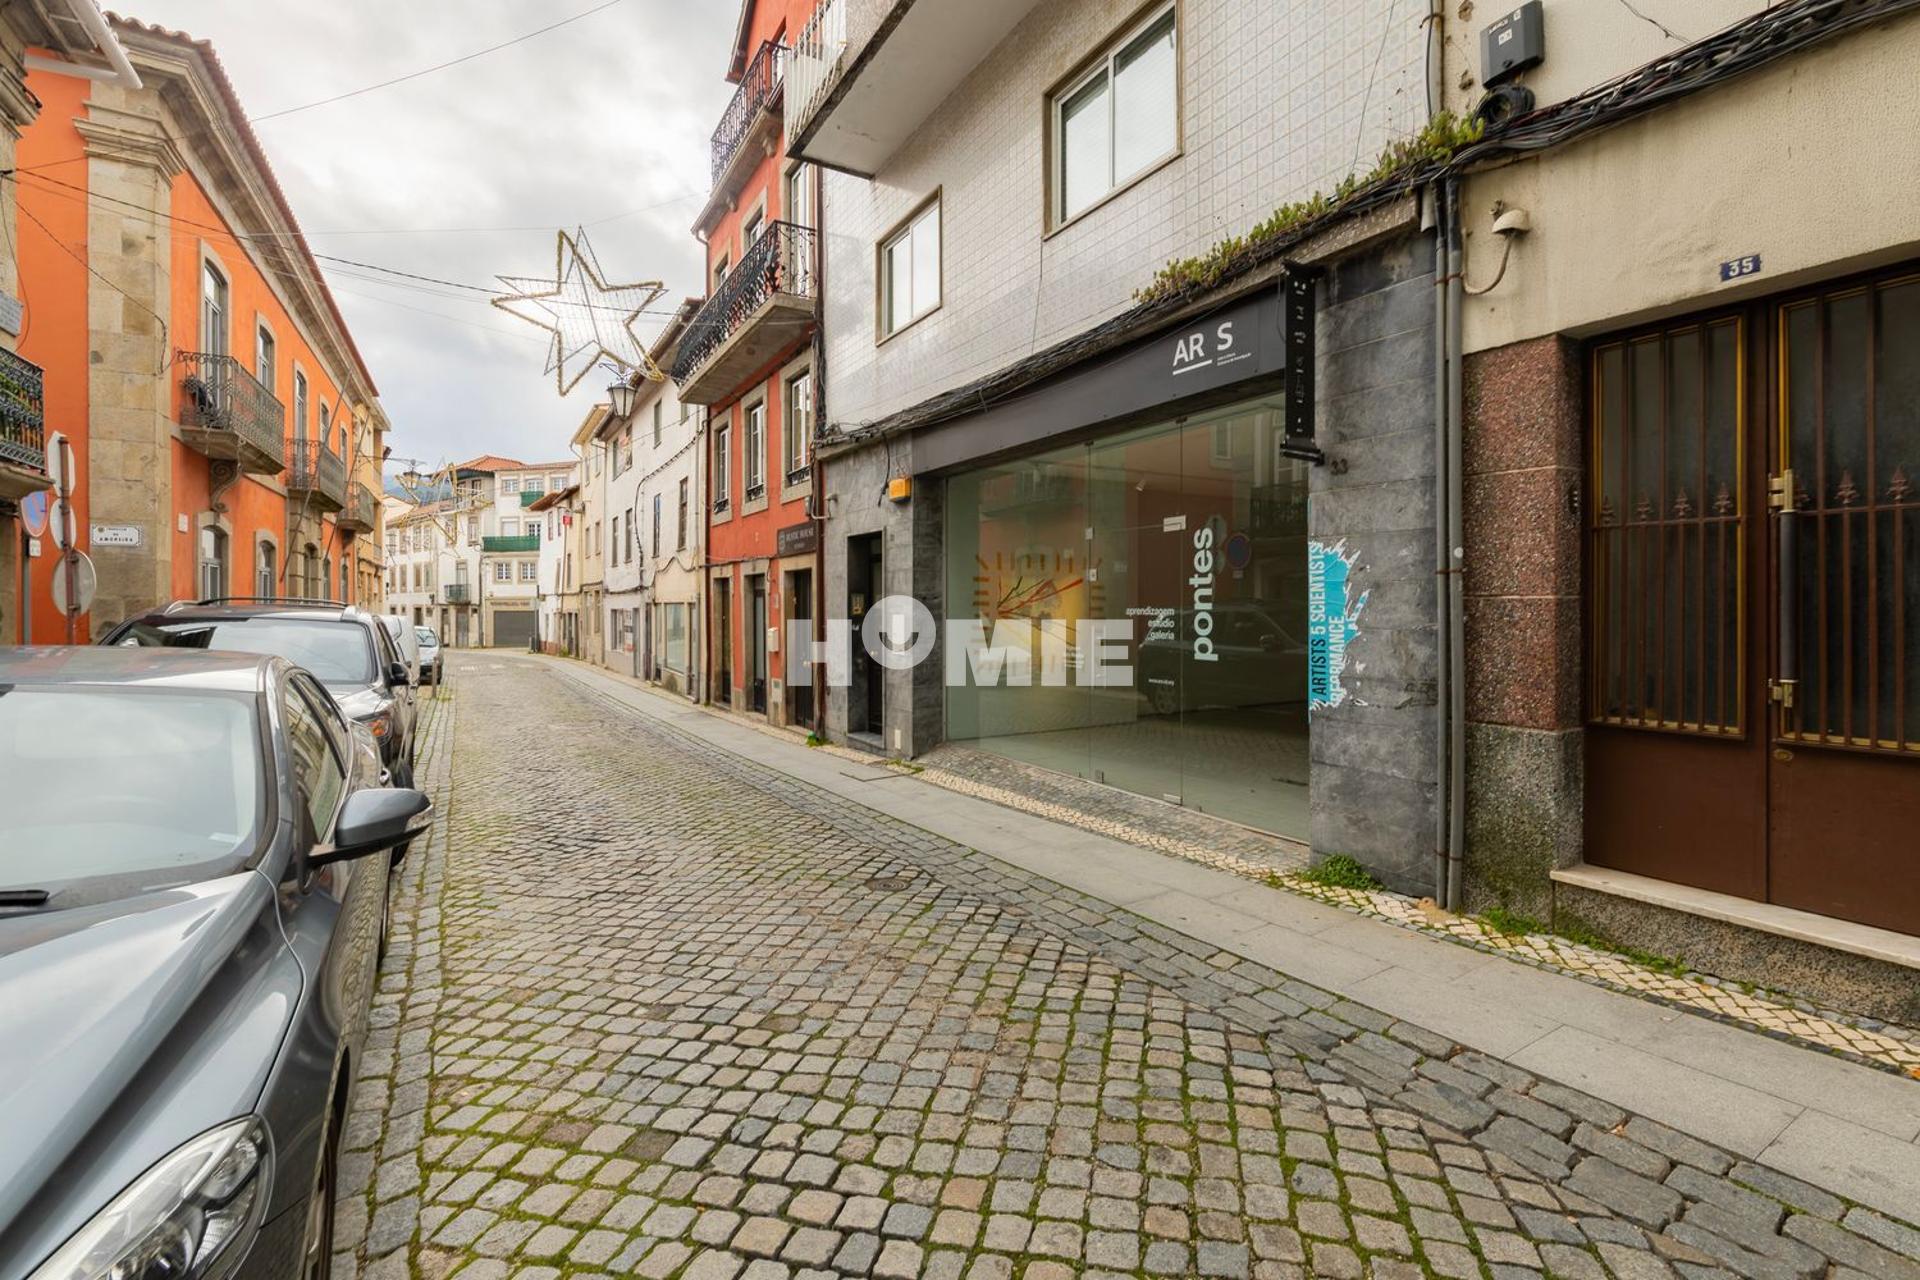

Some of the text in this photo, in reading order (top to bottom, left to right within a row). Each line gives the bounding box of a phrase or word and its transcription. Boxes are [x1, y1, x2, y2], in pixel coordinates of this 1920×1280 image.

[1728, 257, 1754, 277] 35
[1188, 527, 1219, 662] pontes
[1309, 542, 1325, 622] SCIENTISTS
[1126, 607, 1175, 618] aprendizagem
[1150, 630, 1175, 641] galeria
[1310, 638, 1327, 696] ARTISTS
